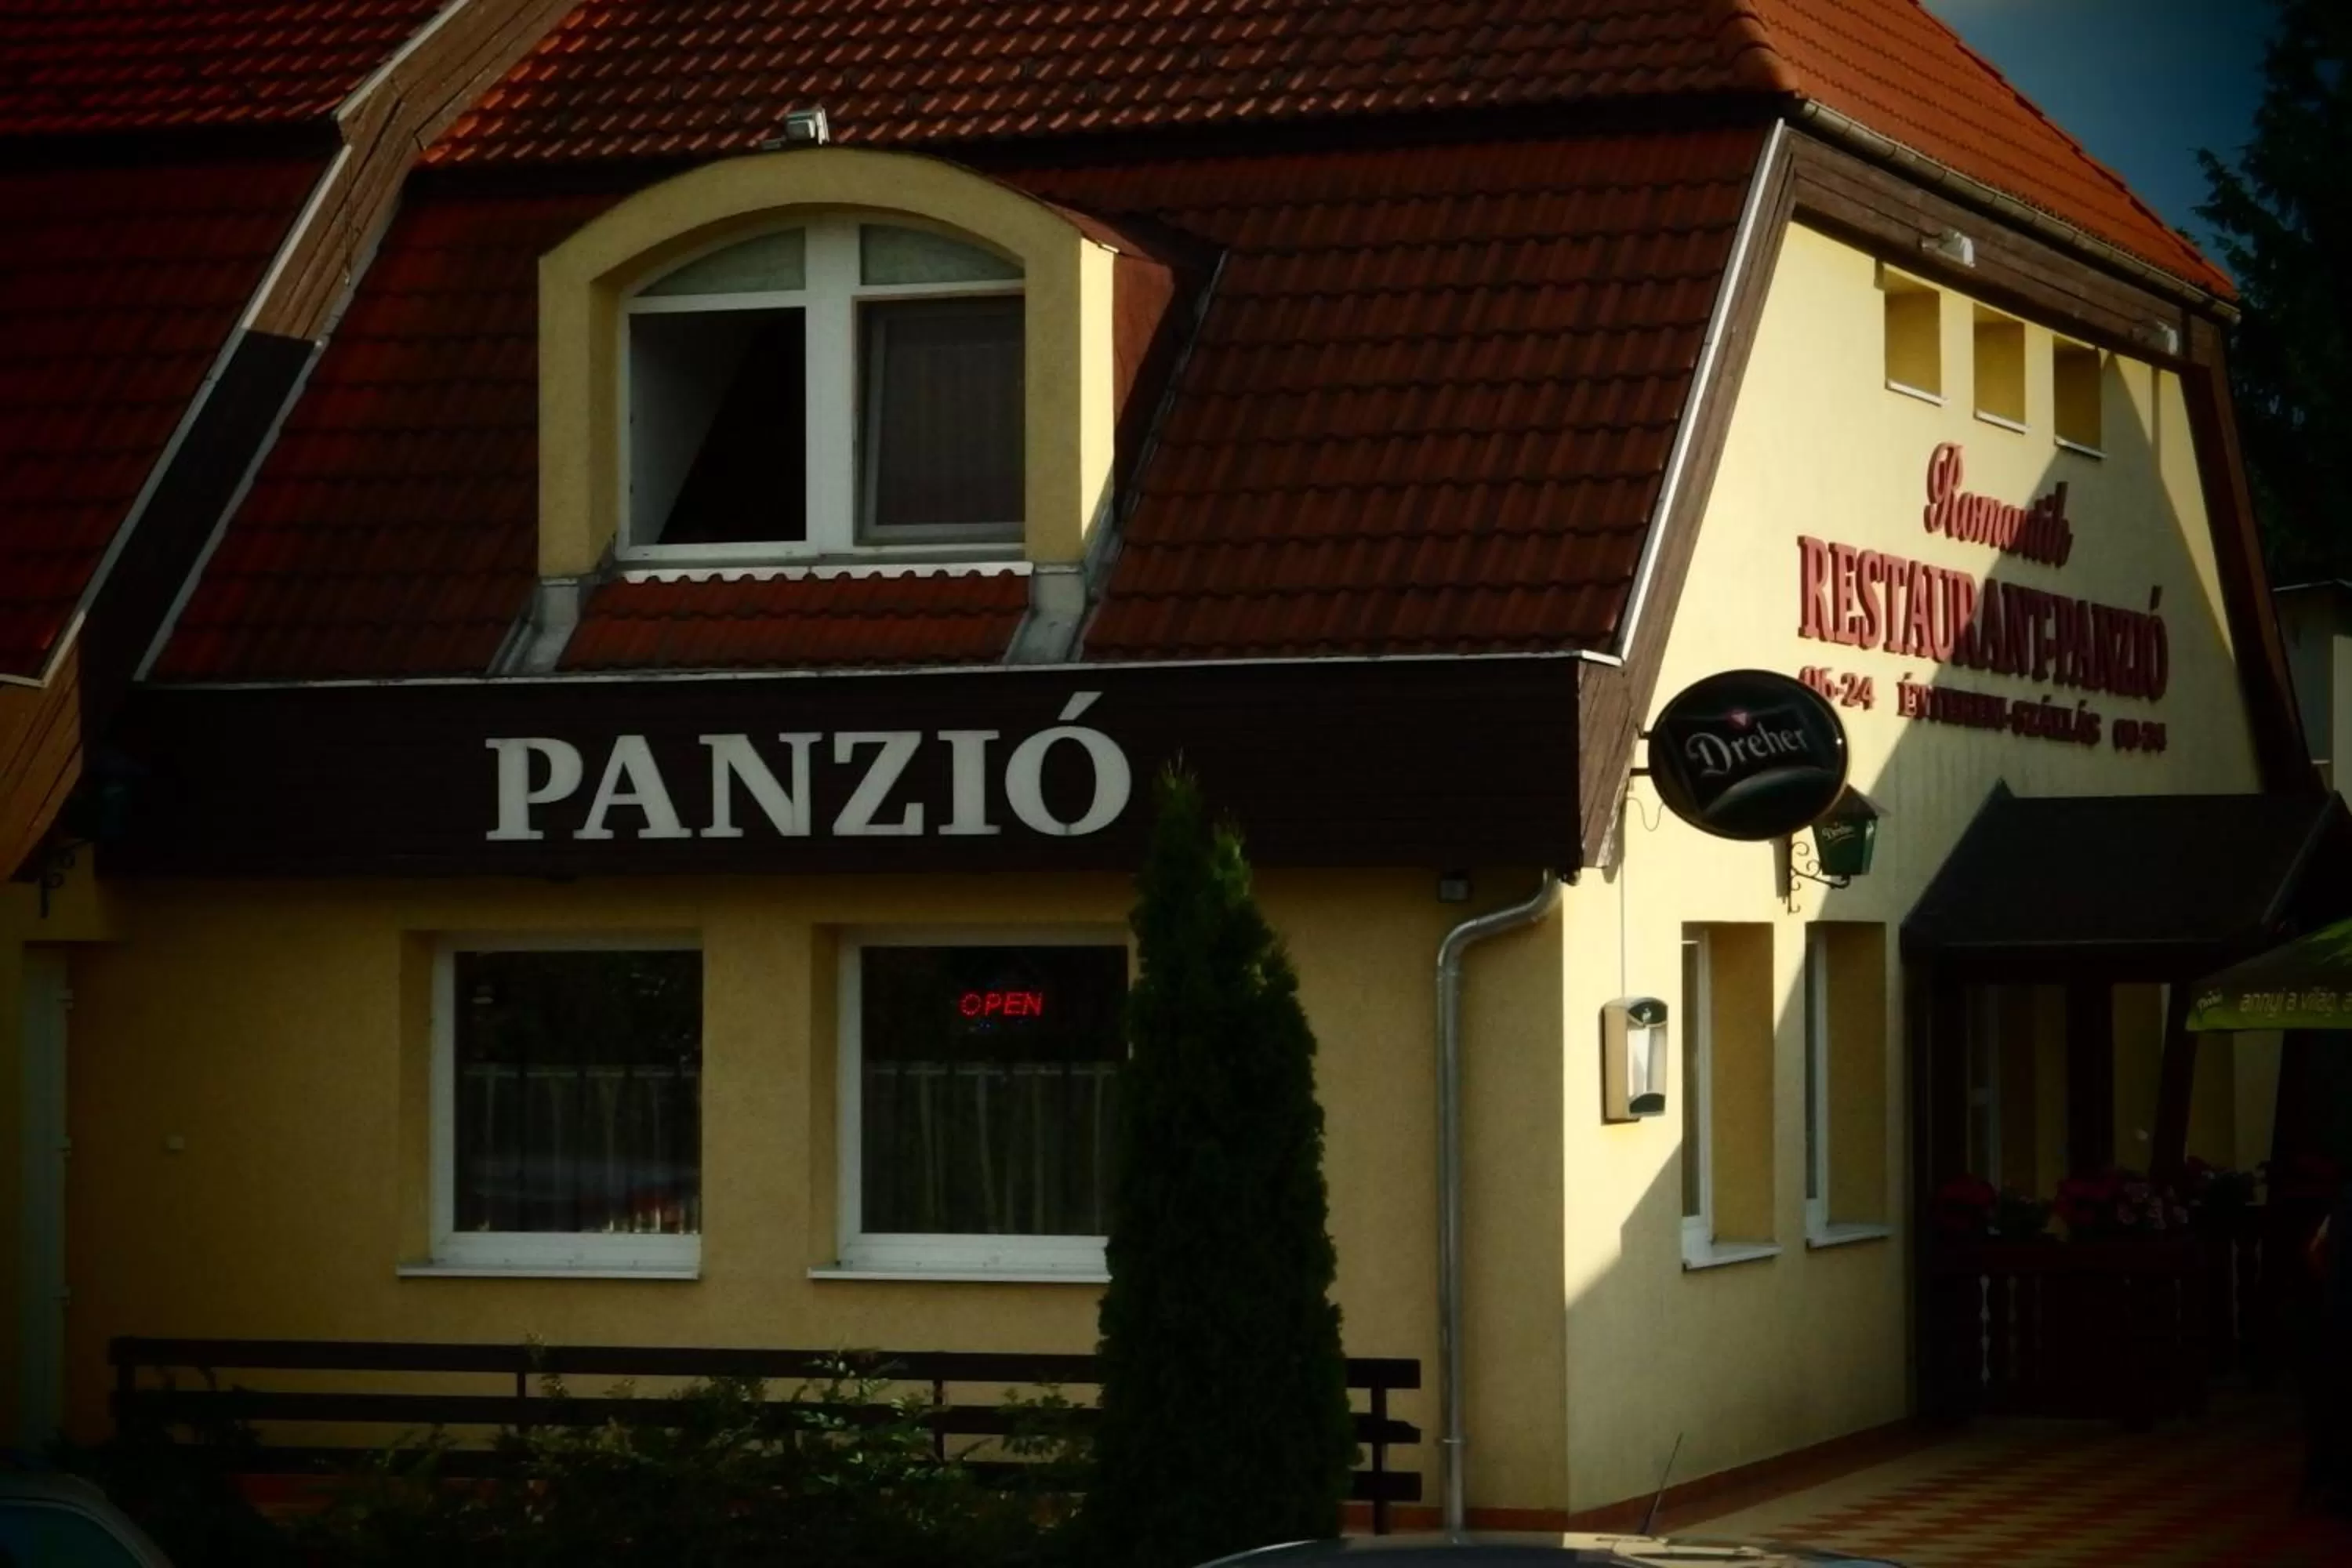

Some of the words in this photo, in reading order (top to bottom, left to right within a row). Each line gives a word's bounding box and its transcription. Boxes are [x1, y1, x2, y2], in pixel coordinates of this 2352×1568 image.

[483, 690, 1133, 841] PANZIÓ
[1686, 720, 1809, 778] Dreher
[958, 989, 1044, 1018] OPEN
